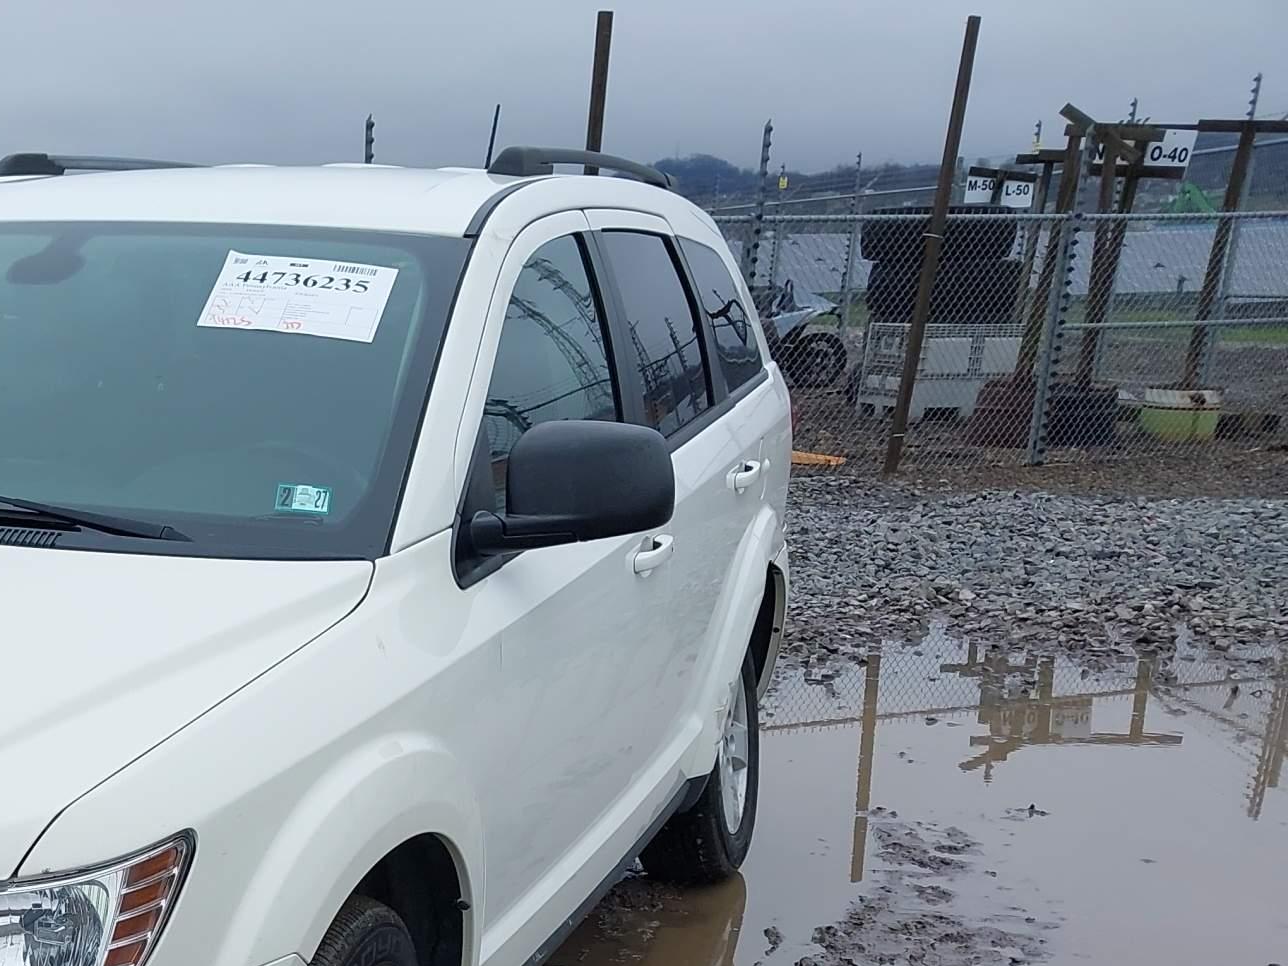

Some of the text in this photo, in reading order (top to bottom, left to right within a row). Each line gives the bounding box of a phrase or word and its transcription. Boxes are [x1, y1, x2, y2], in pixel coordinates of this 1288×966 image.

[1150, 145, 1189, 163] O-40
[967, 179, 996, 191] M-50
[1005, 184, 1030, 196] L-50
[235, 269, 371, 294] 44736235
[281, 487, 328, 510] 2 27
